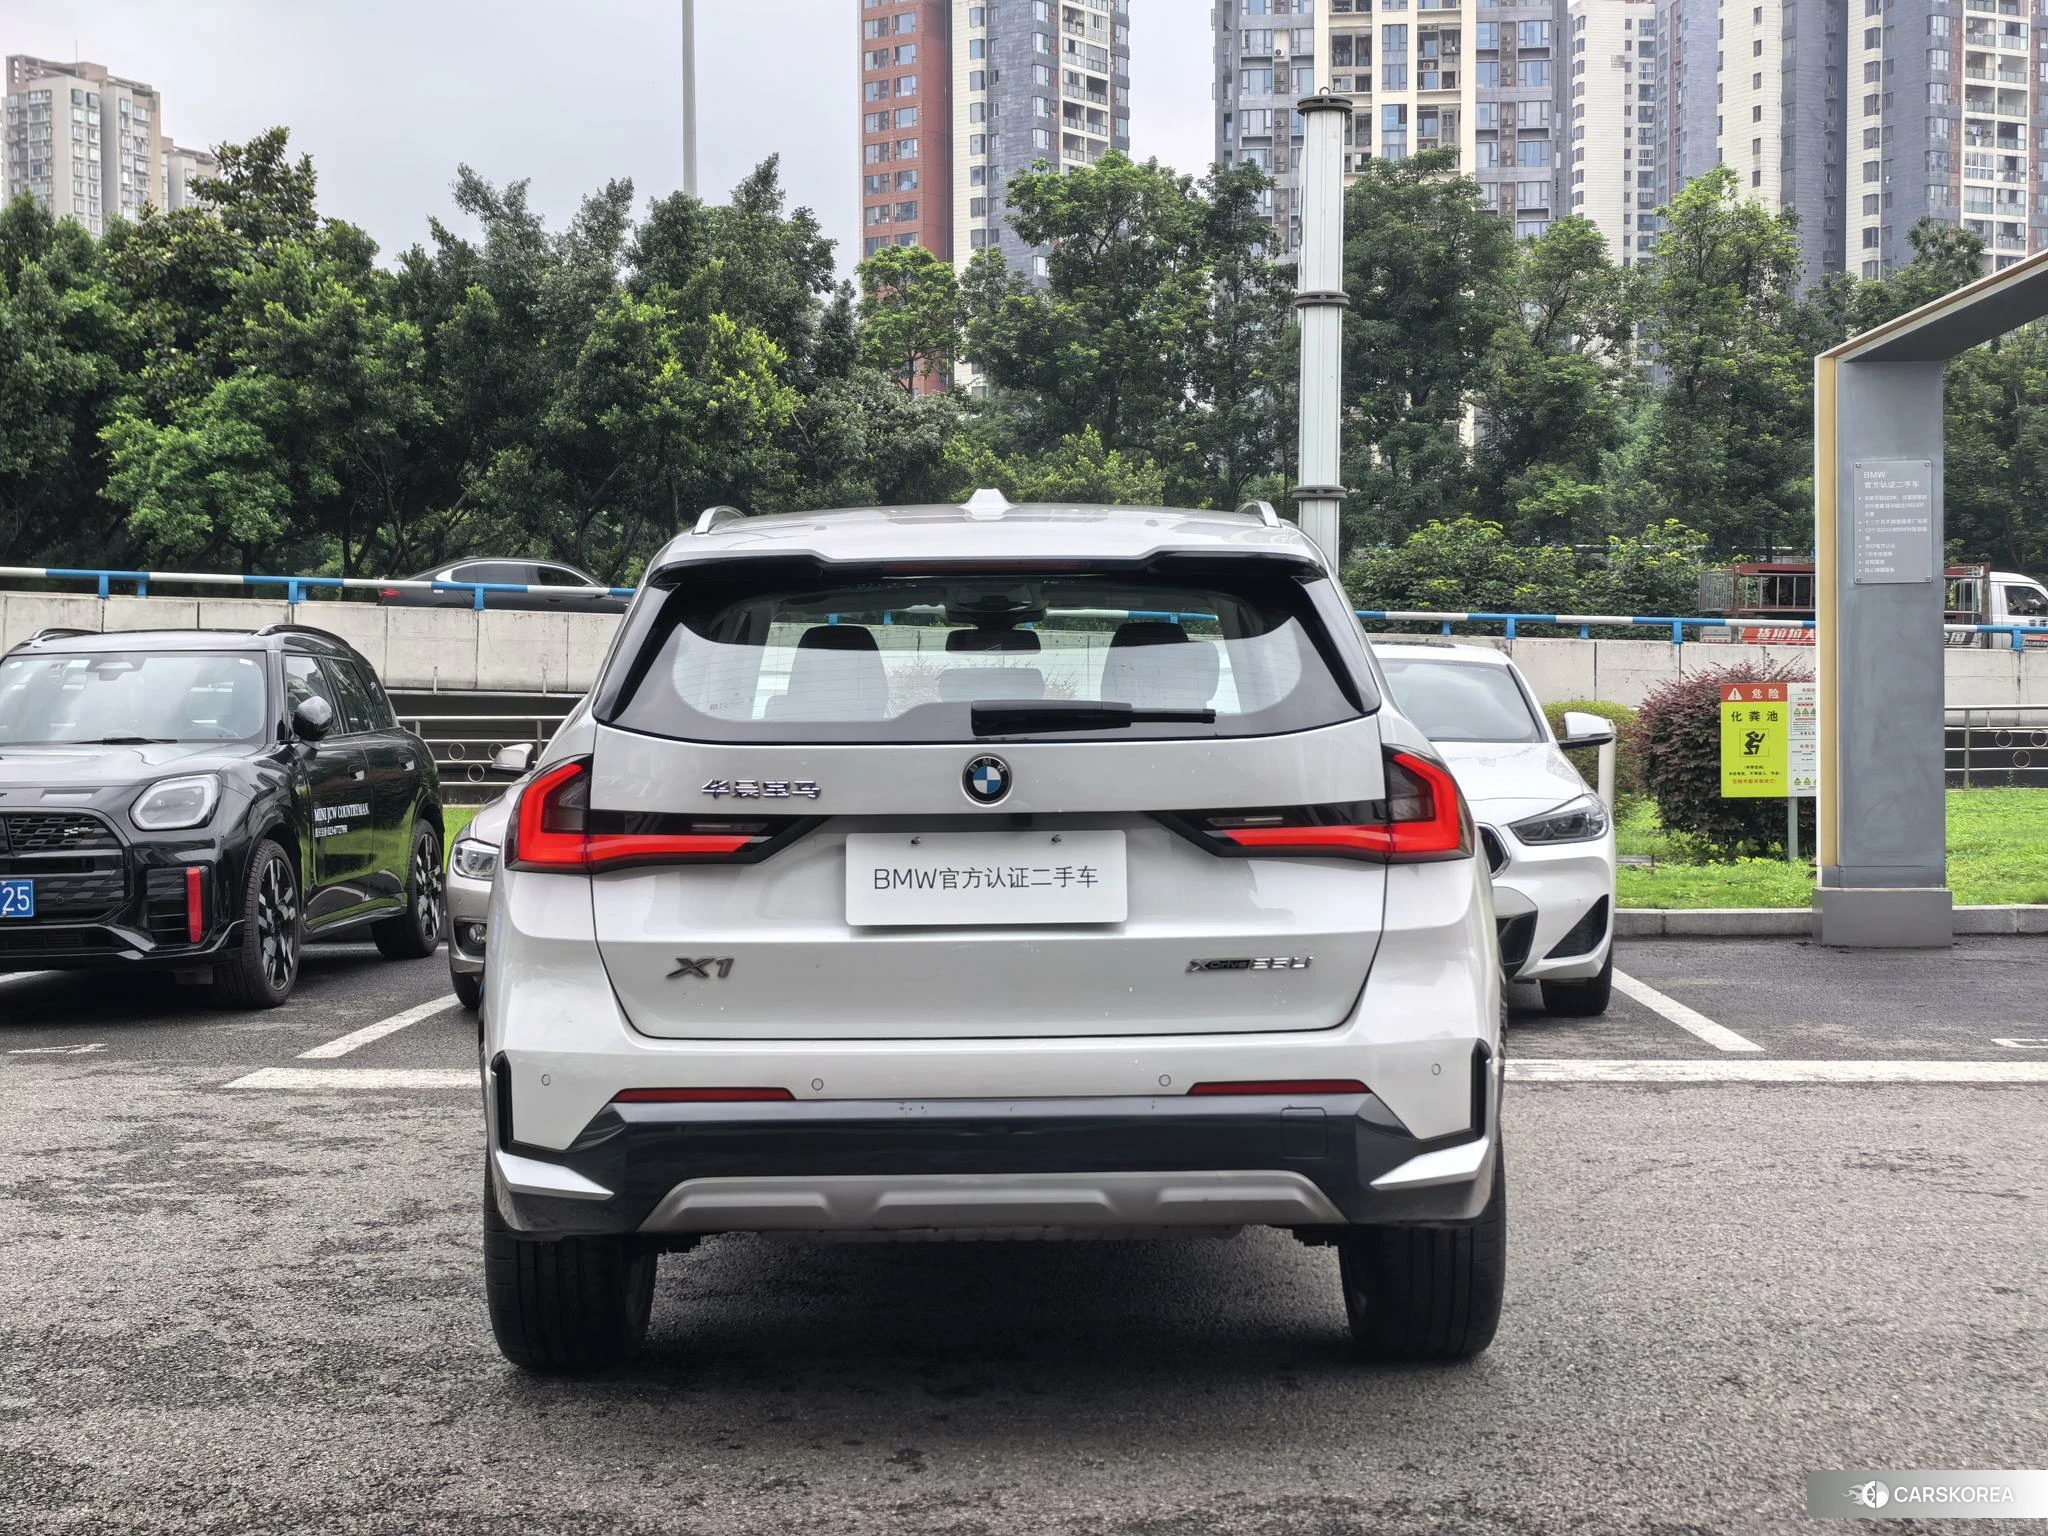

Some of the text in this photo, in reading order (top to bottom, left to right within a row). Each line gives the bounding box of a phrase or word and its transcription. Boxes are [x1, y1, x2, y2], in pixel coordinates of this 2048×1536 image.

[1863, 471, 1886, 479] BMW
[1751, 688, 1780, 699] 危险
[1730, 710, 1779, 722] 化粪池
[701, 779, 821, 799] 华晨宝马
[314, 807, 328, 822] MINI
[873, 865, 1099, 890] BMW官方认证二手车
[665, 957, 735, 979] X1
